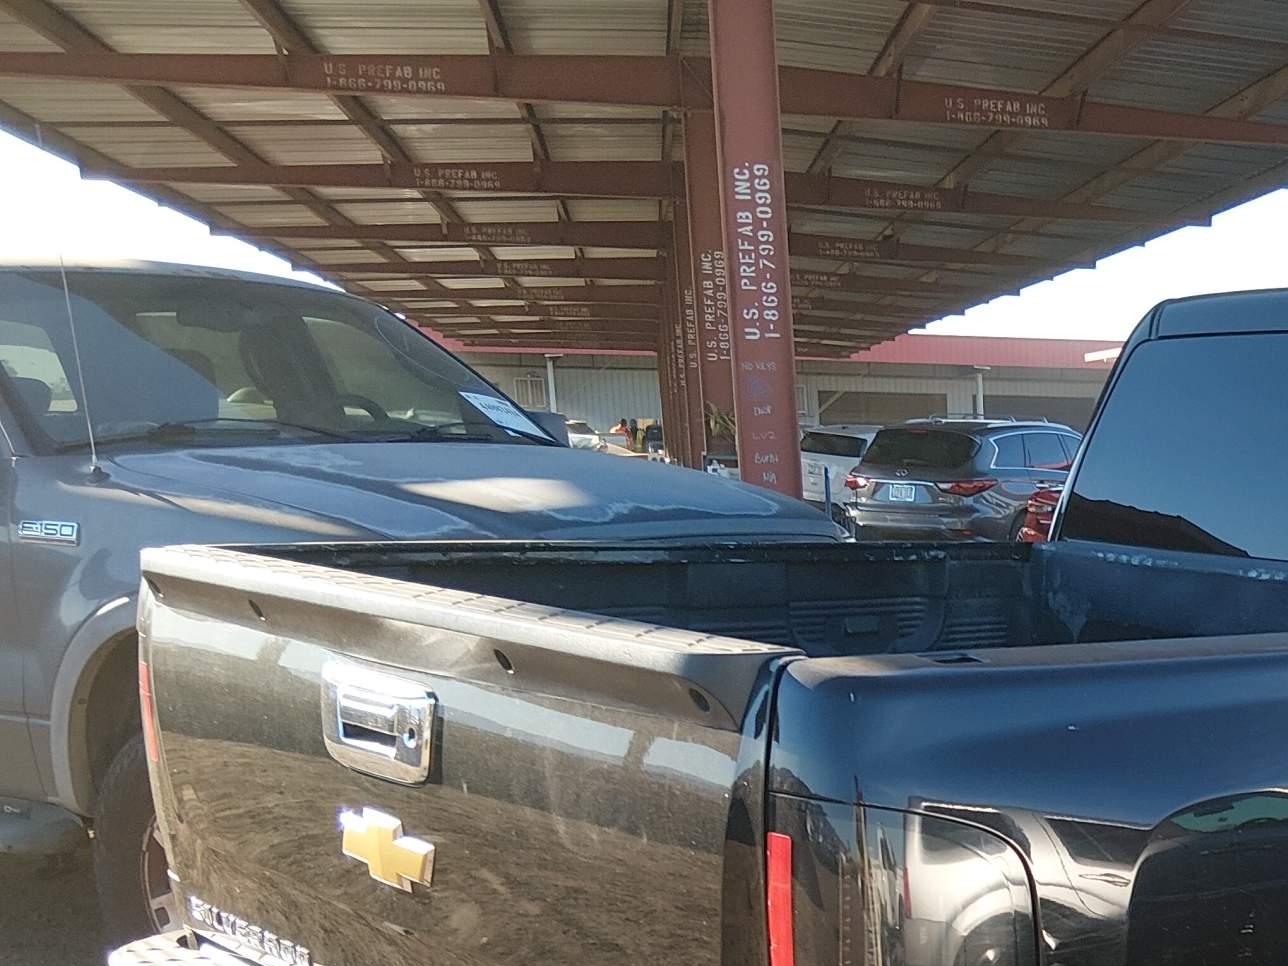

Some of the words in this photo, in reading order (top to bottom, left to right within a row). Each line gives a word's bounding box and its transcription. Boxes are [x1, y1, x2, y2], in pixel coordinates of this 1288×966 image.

[358, 64, 413, 79] PREFAB
[974, 99, 1020, 113] PREFAB
[438, 169, 477, 179] PREFAB
[733, 161, 751, 200] INC.
[701, 250, 713, 274] INC.
[736, 211, 758, 291] PREFAB
[753, 163, 781, 339] 1-866-799-0969
[703, 280, 717, 330] PREFAB
[714, 251, 731, 360] 1-866-799-0969
[743, 302, 761, 341] U.S.
[706, 336, 718, 361] U.S.
